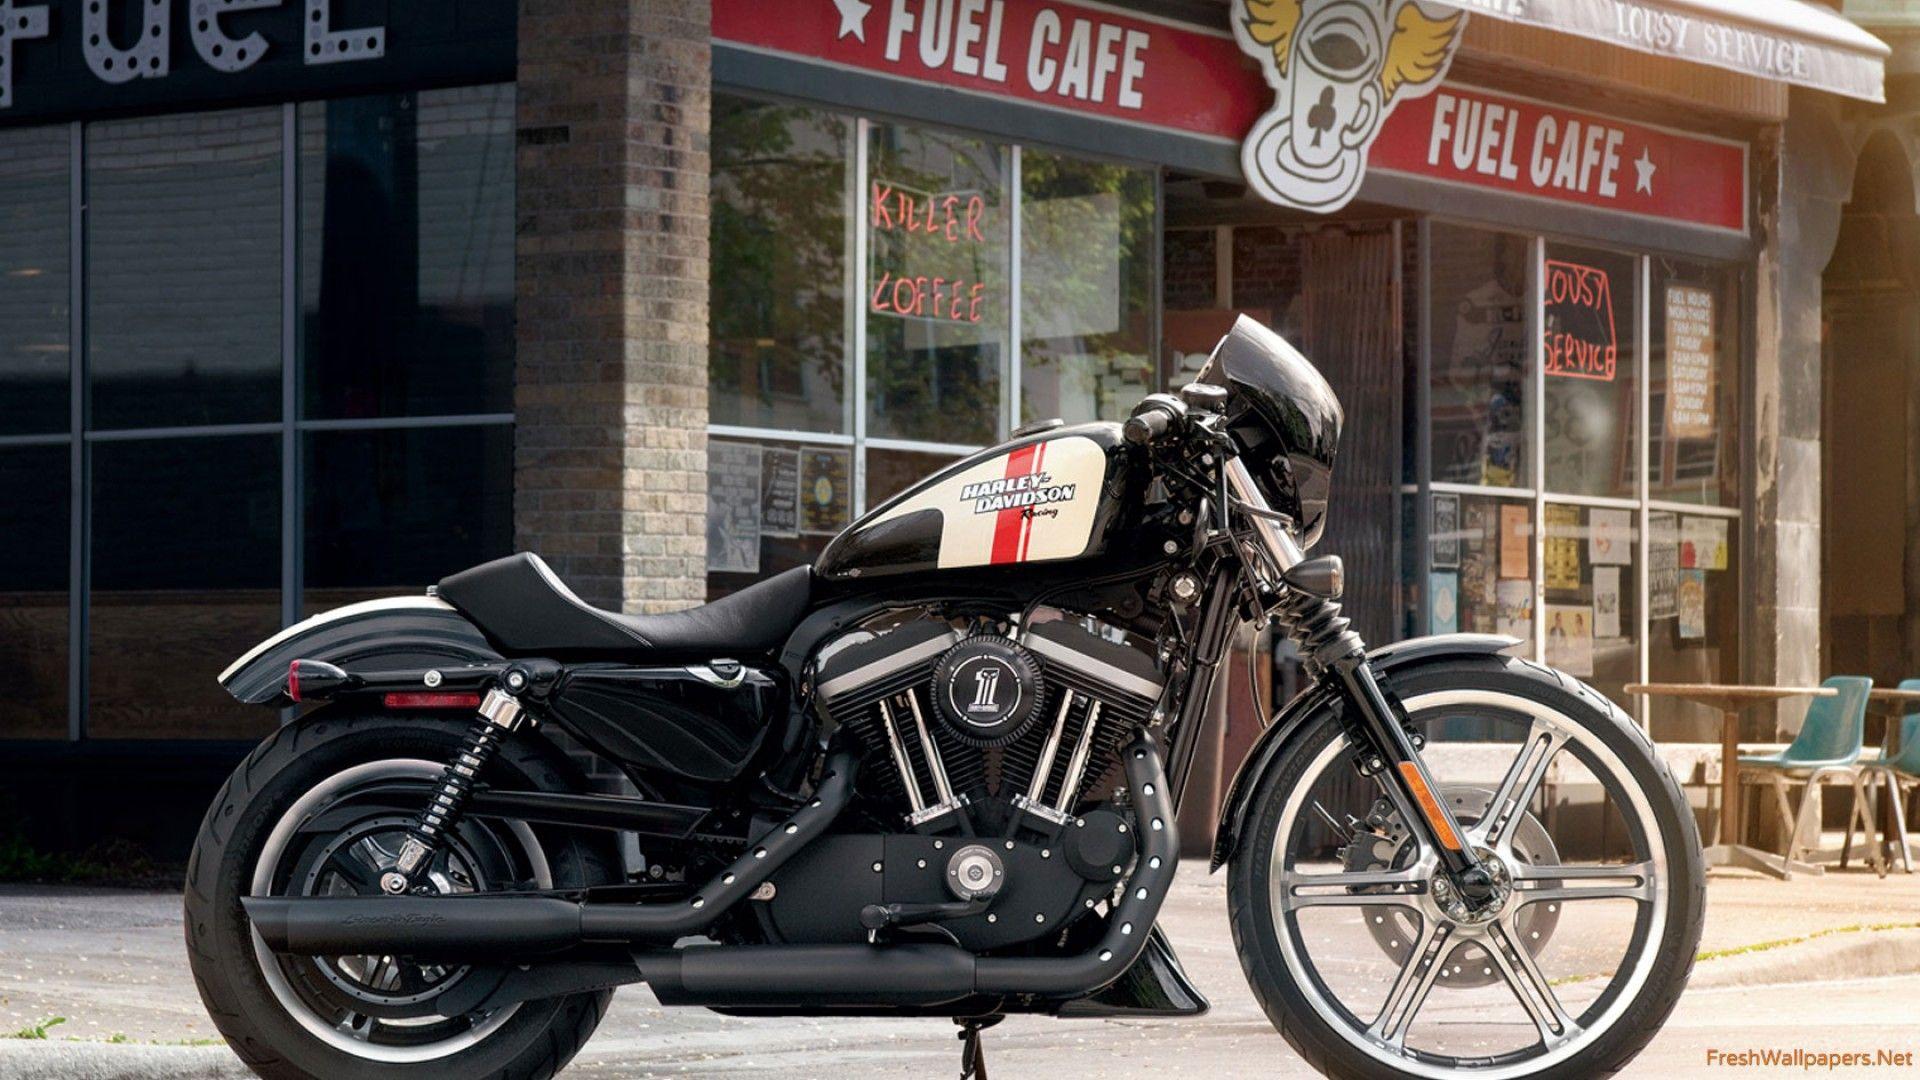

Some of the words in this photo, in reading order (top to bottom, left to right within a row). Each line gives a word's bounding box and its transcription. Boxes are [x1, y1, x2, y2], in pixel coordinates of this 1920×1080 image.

[884, 0, 1008, 82] FUEL
[1027, 8, 1151, 110] CAFE
[1615, 3, 1690, 49] LOUSY
[1704, 24, 1811, 78] SERVICE
[1427, 93, 1519, 181] FUEL
[1530, 114, 1625, 198] CAFE
[872, 181, 986, 242] KILLER
[975, 483, 1076, 514] DAVIDSON
[1020, 507, 1058, 520] Racing
